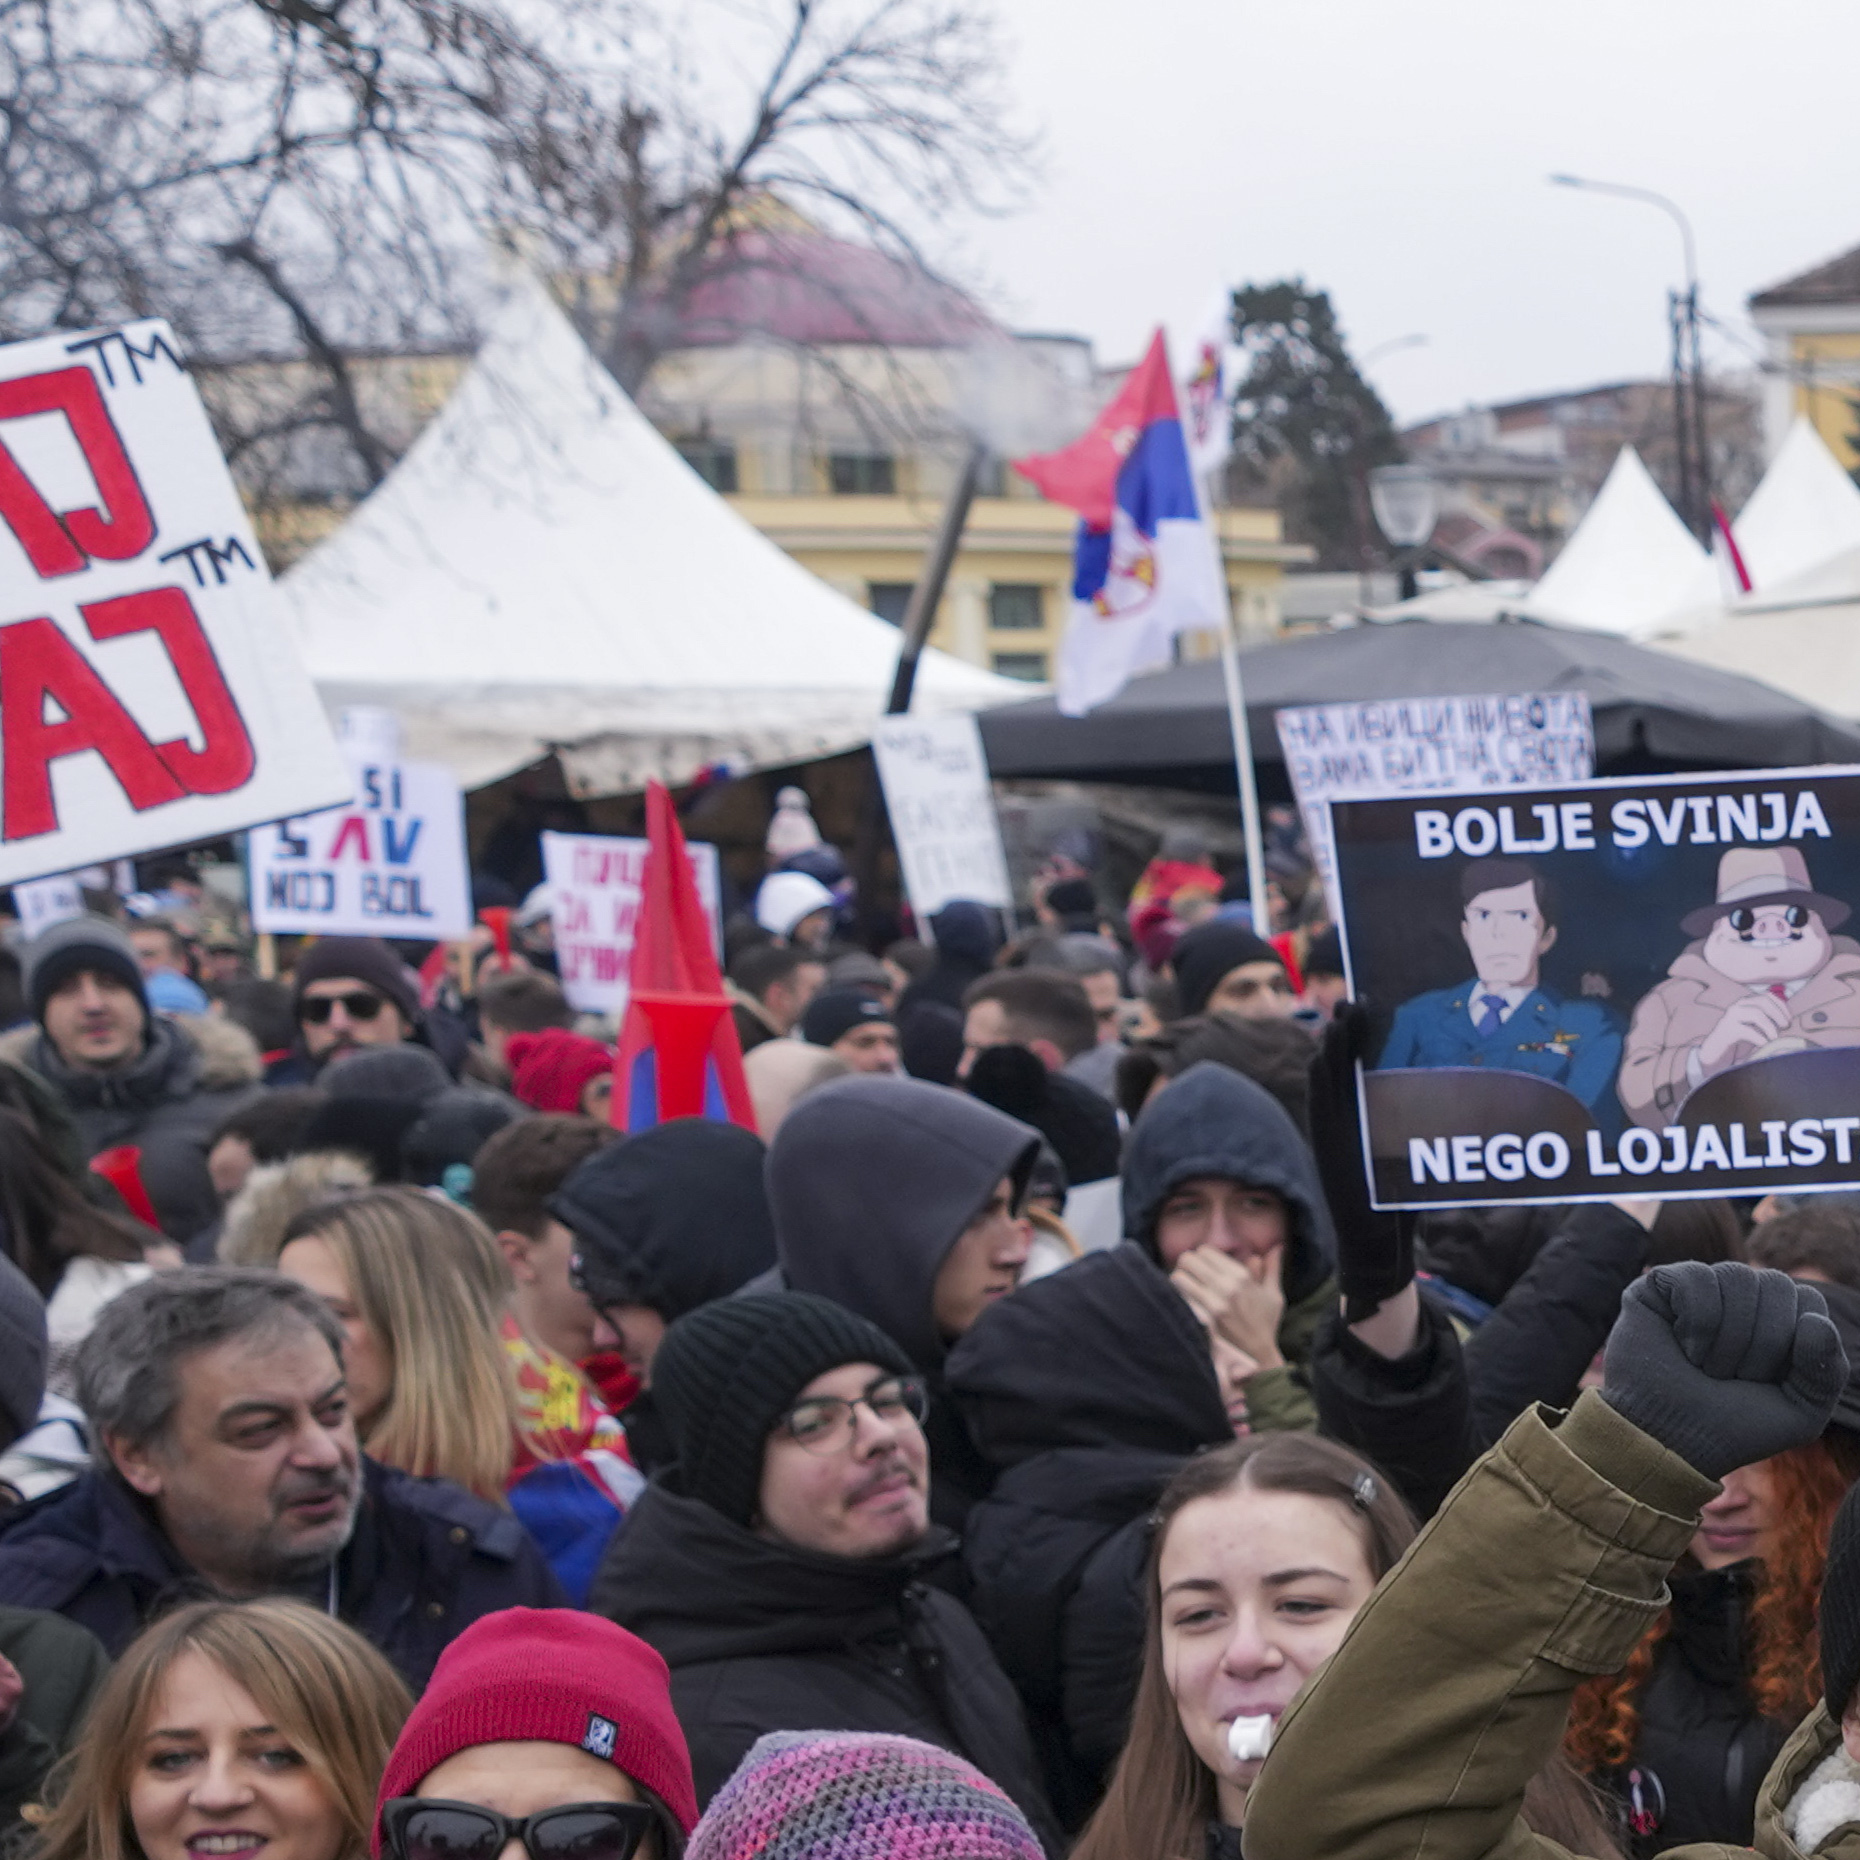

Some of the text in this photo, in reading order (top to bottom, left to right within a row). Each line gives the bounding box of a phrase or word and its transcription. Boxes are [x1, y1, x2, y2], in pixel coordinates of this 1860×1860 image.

[1413, 791, 1832, 859] BOLJE SVINJA
[1407, 1129, 1571, 1184] NEGO
